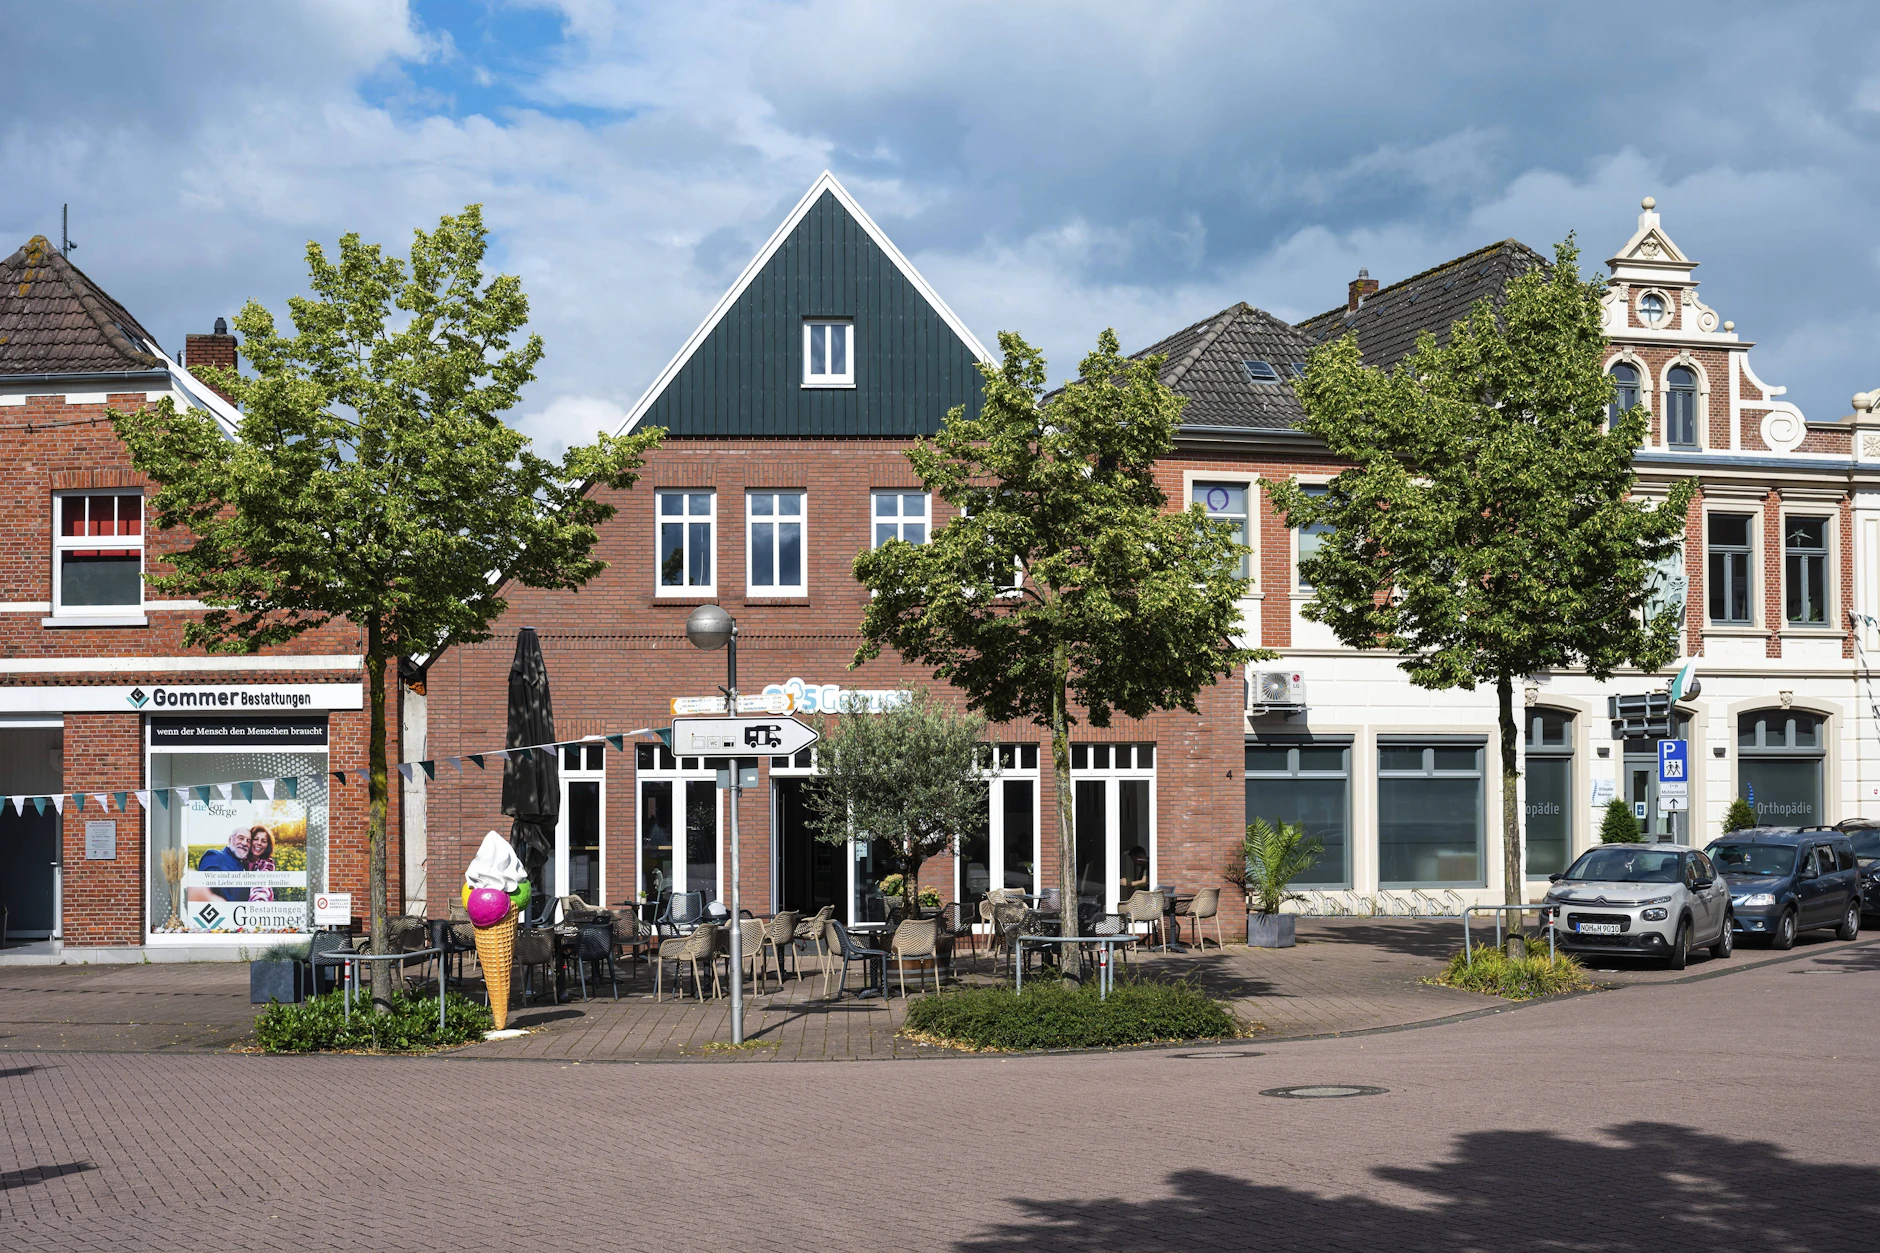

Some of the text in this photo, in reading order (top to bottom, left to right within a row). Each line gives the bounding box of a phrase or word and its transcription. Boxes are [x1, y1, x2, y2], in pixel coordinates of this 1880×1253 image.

[153, 688, 311, 708] Gommer Bestattungen
[180, 727, 195, 735] der
[196, 727, 228, 735] Mensch
[230, 727, 245, 735] den
[247, 727, 289, 735] Menschen
[291, 727, 323, 735] braucht
[1663, 742, 1676, 759] P
[1226, 769, 1232, 780] 4
[192, 802, 206, 811] die
[1757, 802, 1812, 817] Orthopädie
[209, 808, 237, 818] Sorge
[233, 905, 302, 926] Gommer
[249, 906, 302, 914] Bestattungen
